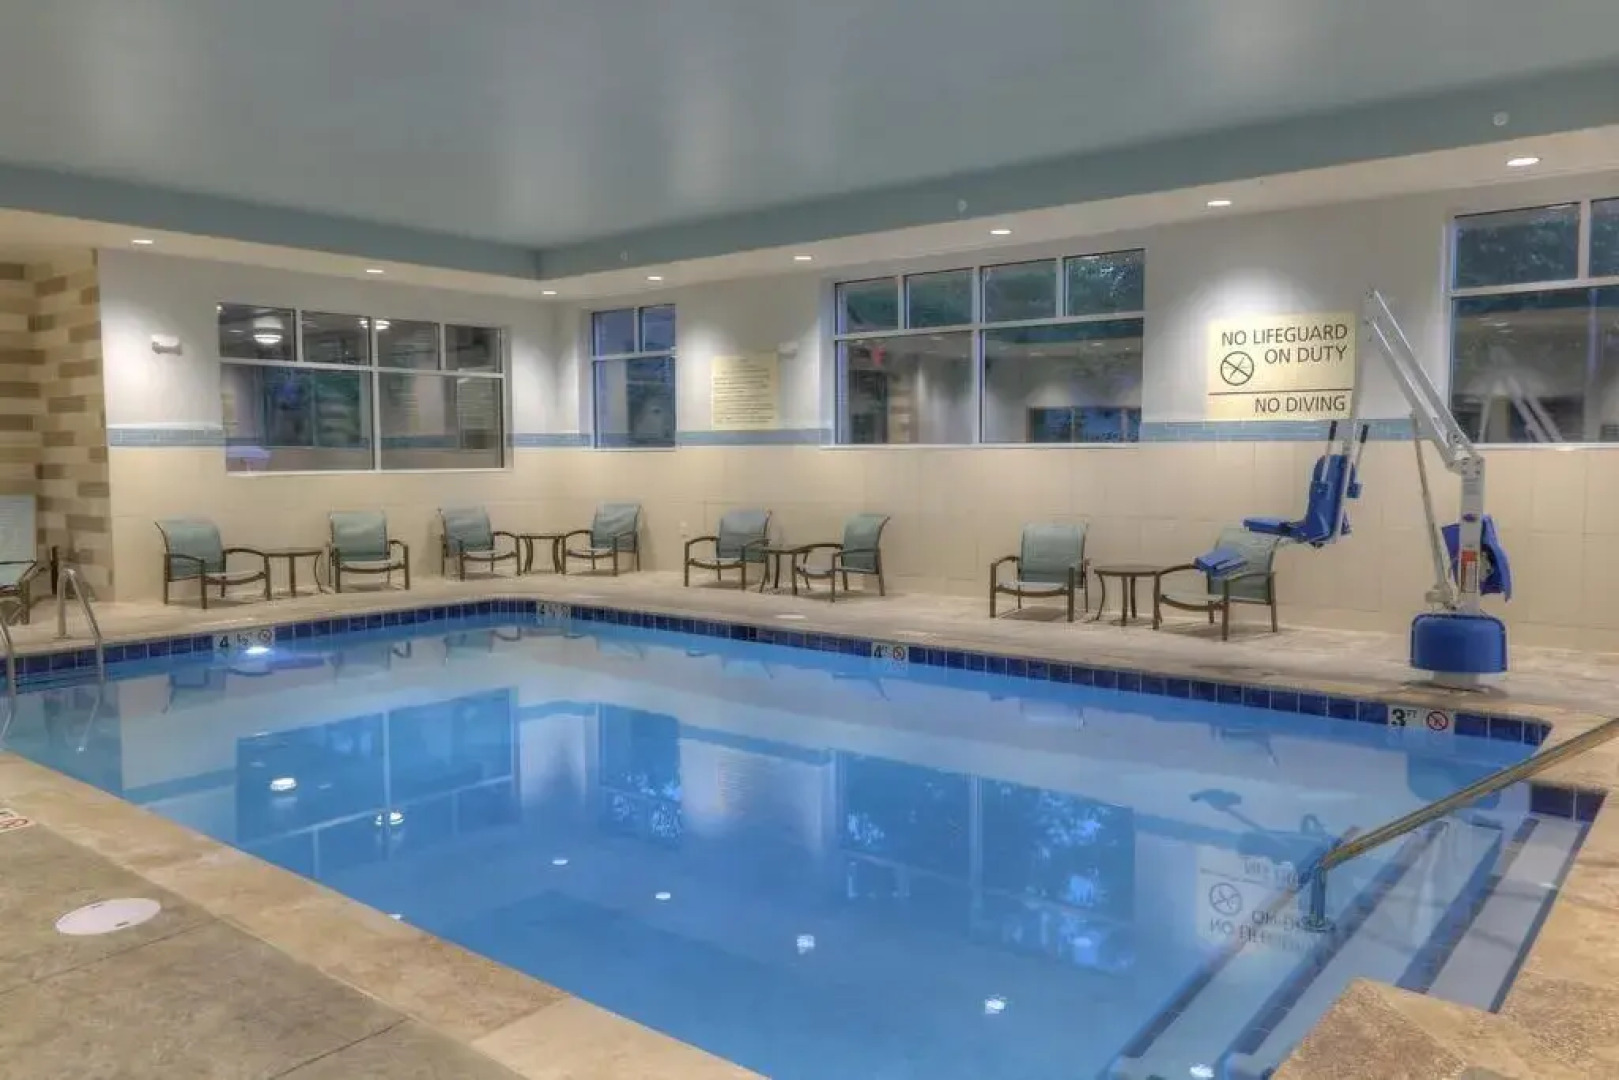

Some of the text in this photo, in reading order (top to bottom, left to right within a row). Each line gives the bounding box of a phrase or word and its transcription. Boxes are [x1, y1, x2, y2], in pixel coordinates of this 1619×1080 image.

[1222, 324, 1347, 346] NO LIFEGUARD
[1264, 345, 1347, 364] ON DUTY
[1254, 395, 1346, 413] NO DIVING
[219, 635, 229, 647] 4
[873, 645, 882, 658] 4
[1391, 708, 1406, 727] 3
